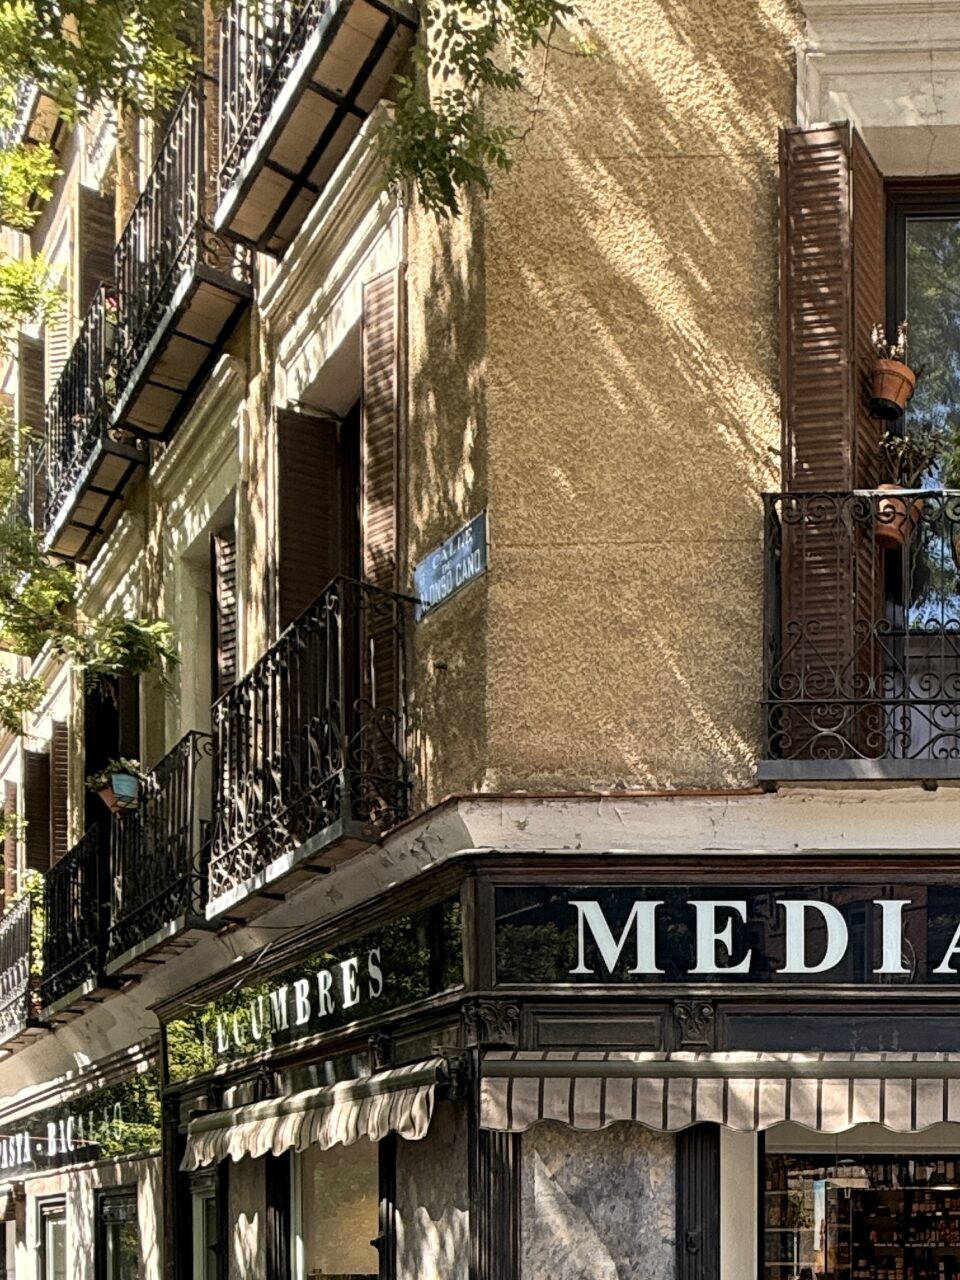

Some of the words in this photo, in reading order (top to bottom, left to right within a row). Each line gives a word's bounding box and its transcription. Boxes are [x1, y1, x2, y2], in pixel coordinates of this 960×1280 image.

[431, 527, 474, 569] CALLE
[420, 571, 453, 611] ALONSO
[455, 548, 481, 587] CANO
[0, 1130, 32, 1169] ASTA
